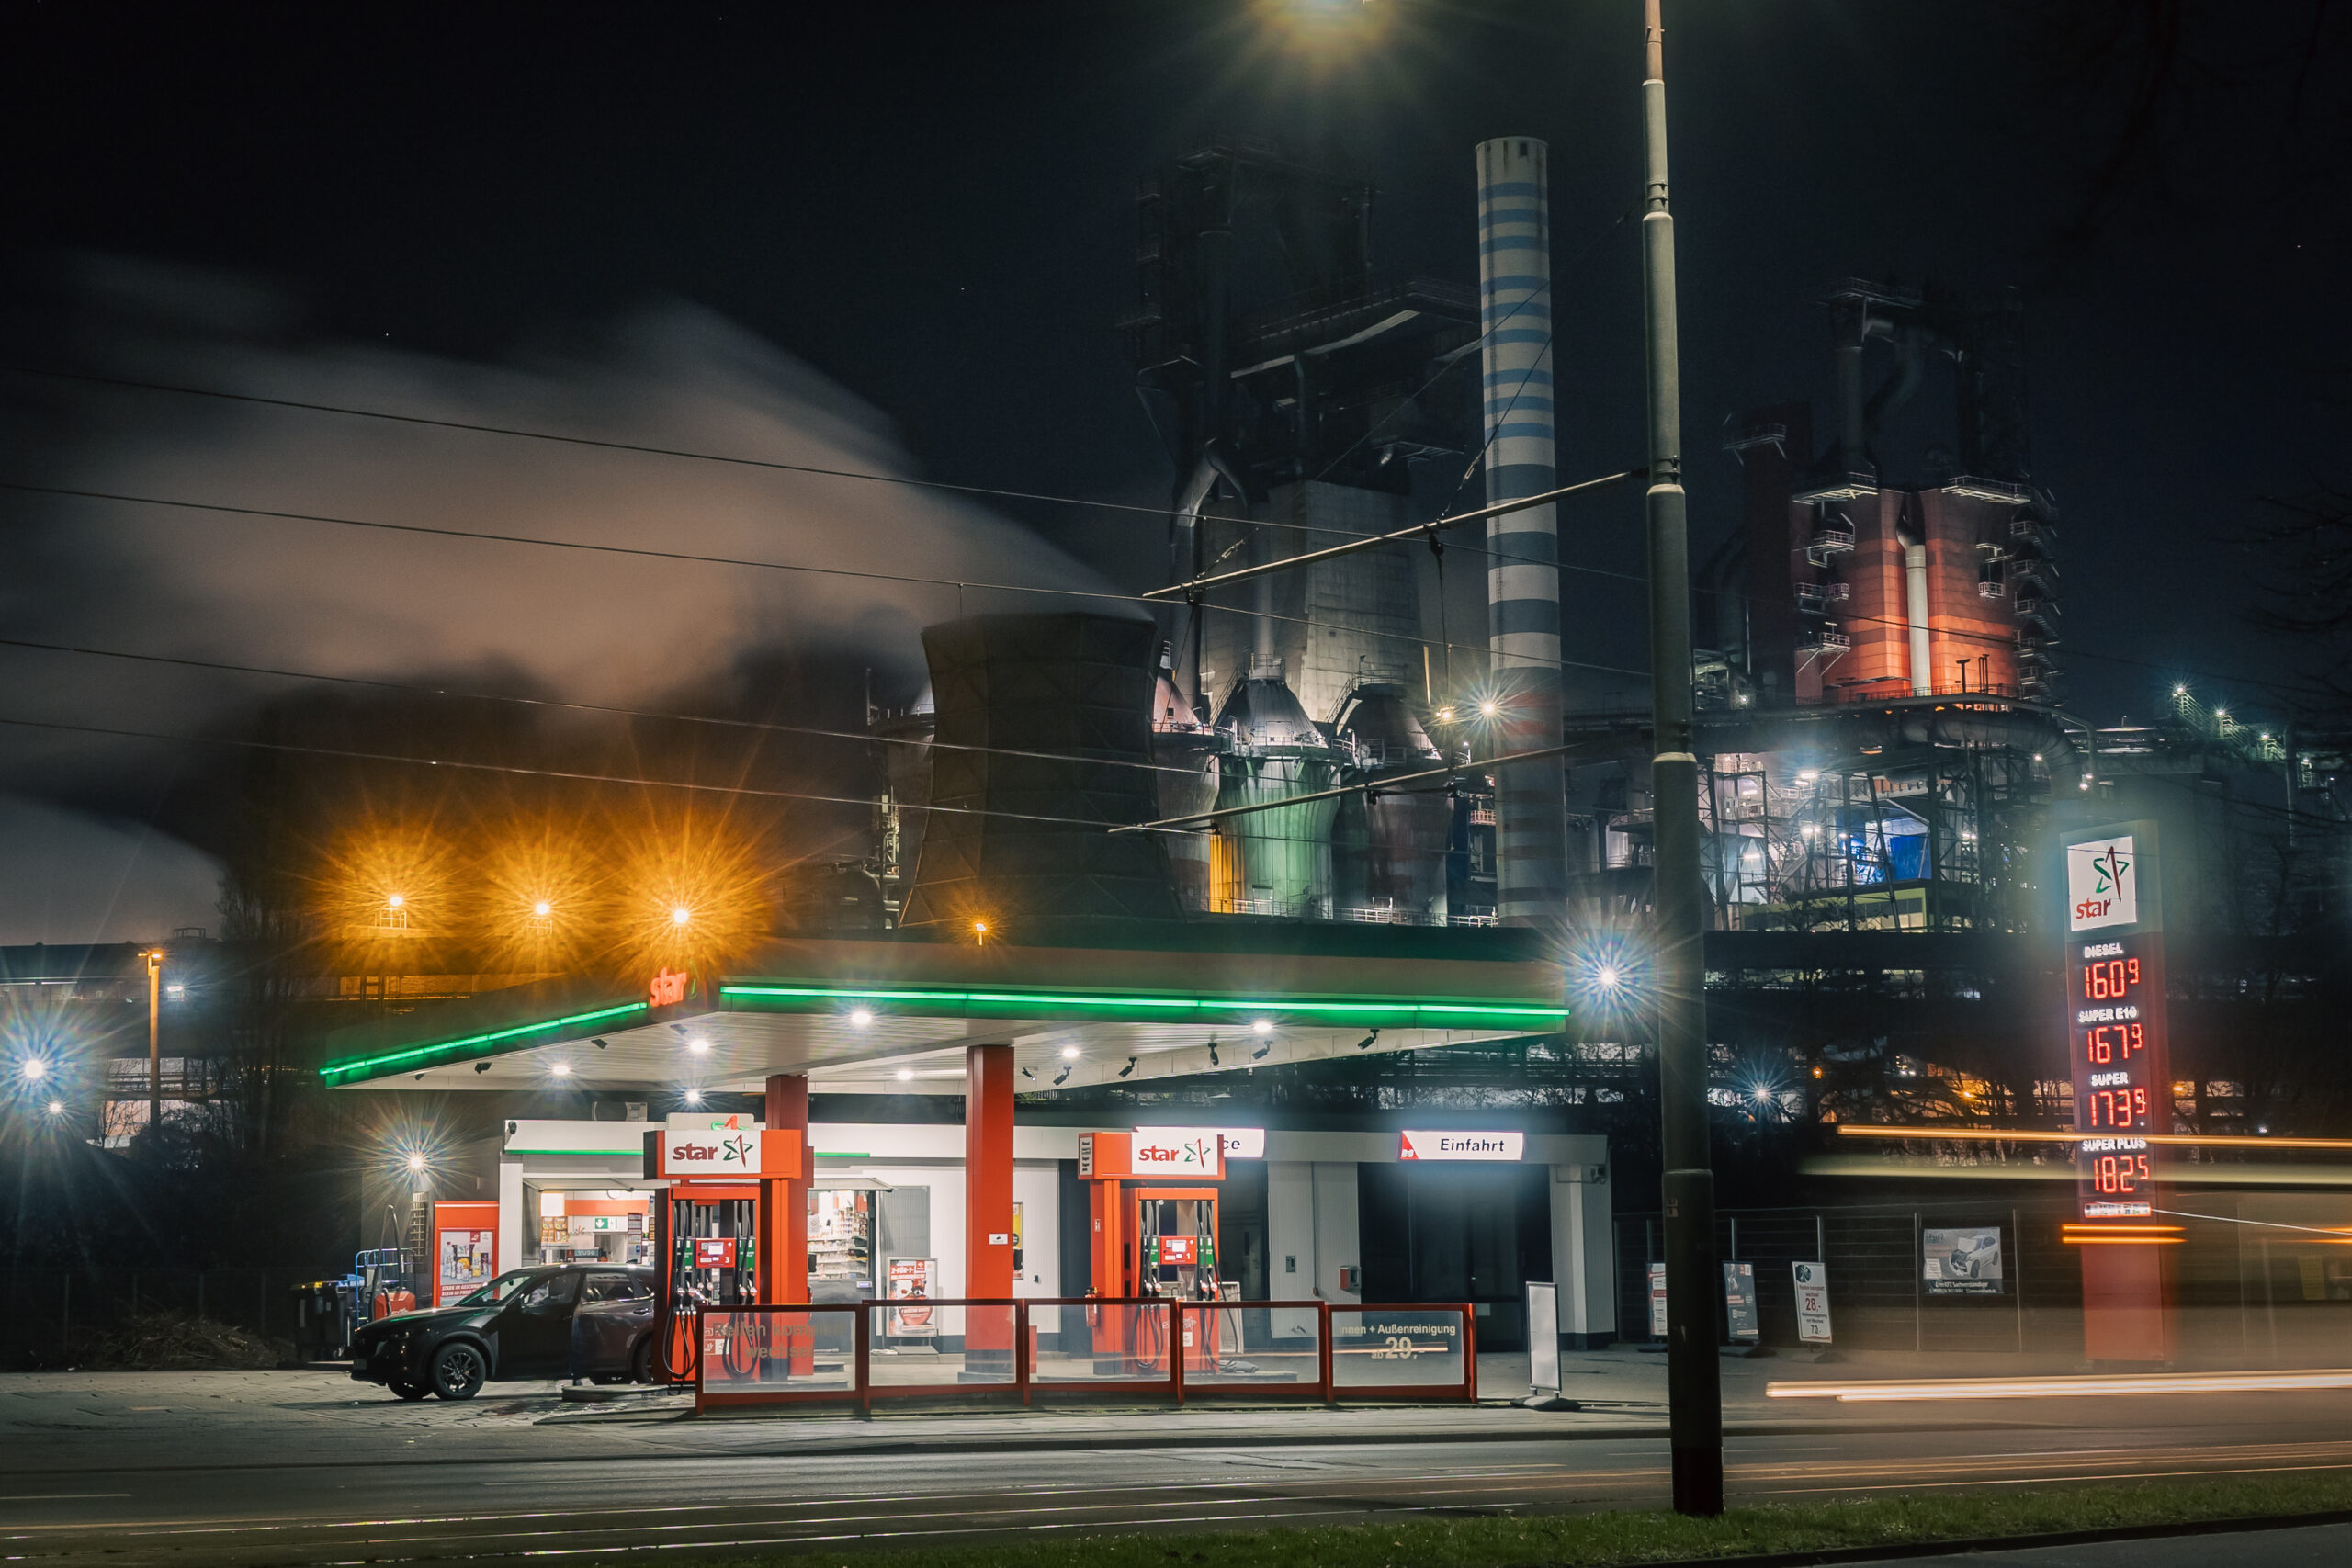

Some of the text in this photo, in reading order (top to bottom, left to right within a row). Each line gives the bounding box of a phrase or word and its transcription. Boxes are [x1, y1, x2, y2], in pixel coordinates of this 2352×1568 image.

[2076, 897, 2111, 919] star
[2084, 942, 2124, 958] DIESEL
[650, 966, 687, 1008] star
[2078, 1006, 2138, 1022] SUPER E10
[2091, 1071, 2129, 1087] SUPER
[673, 1143, 718, 1161] star
[1223, 1138, 1240, 1150] ce
[1440, 1138, 1506, 1152] Einfahrt
[2083, 1137, 2148, 1152] SUPER PLUS
[1138, 1145, 1179, 1162] star
[724, 1256, 729, 1264] 3
[1340, 1325, 1366, 1334] Innen
[1377, 1324, 1456, 1336] Außenreinigung
[1371, 1351, 1384, 1359] ab
